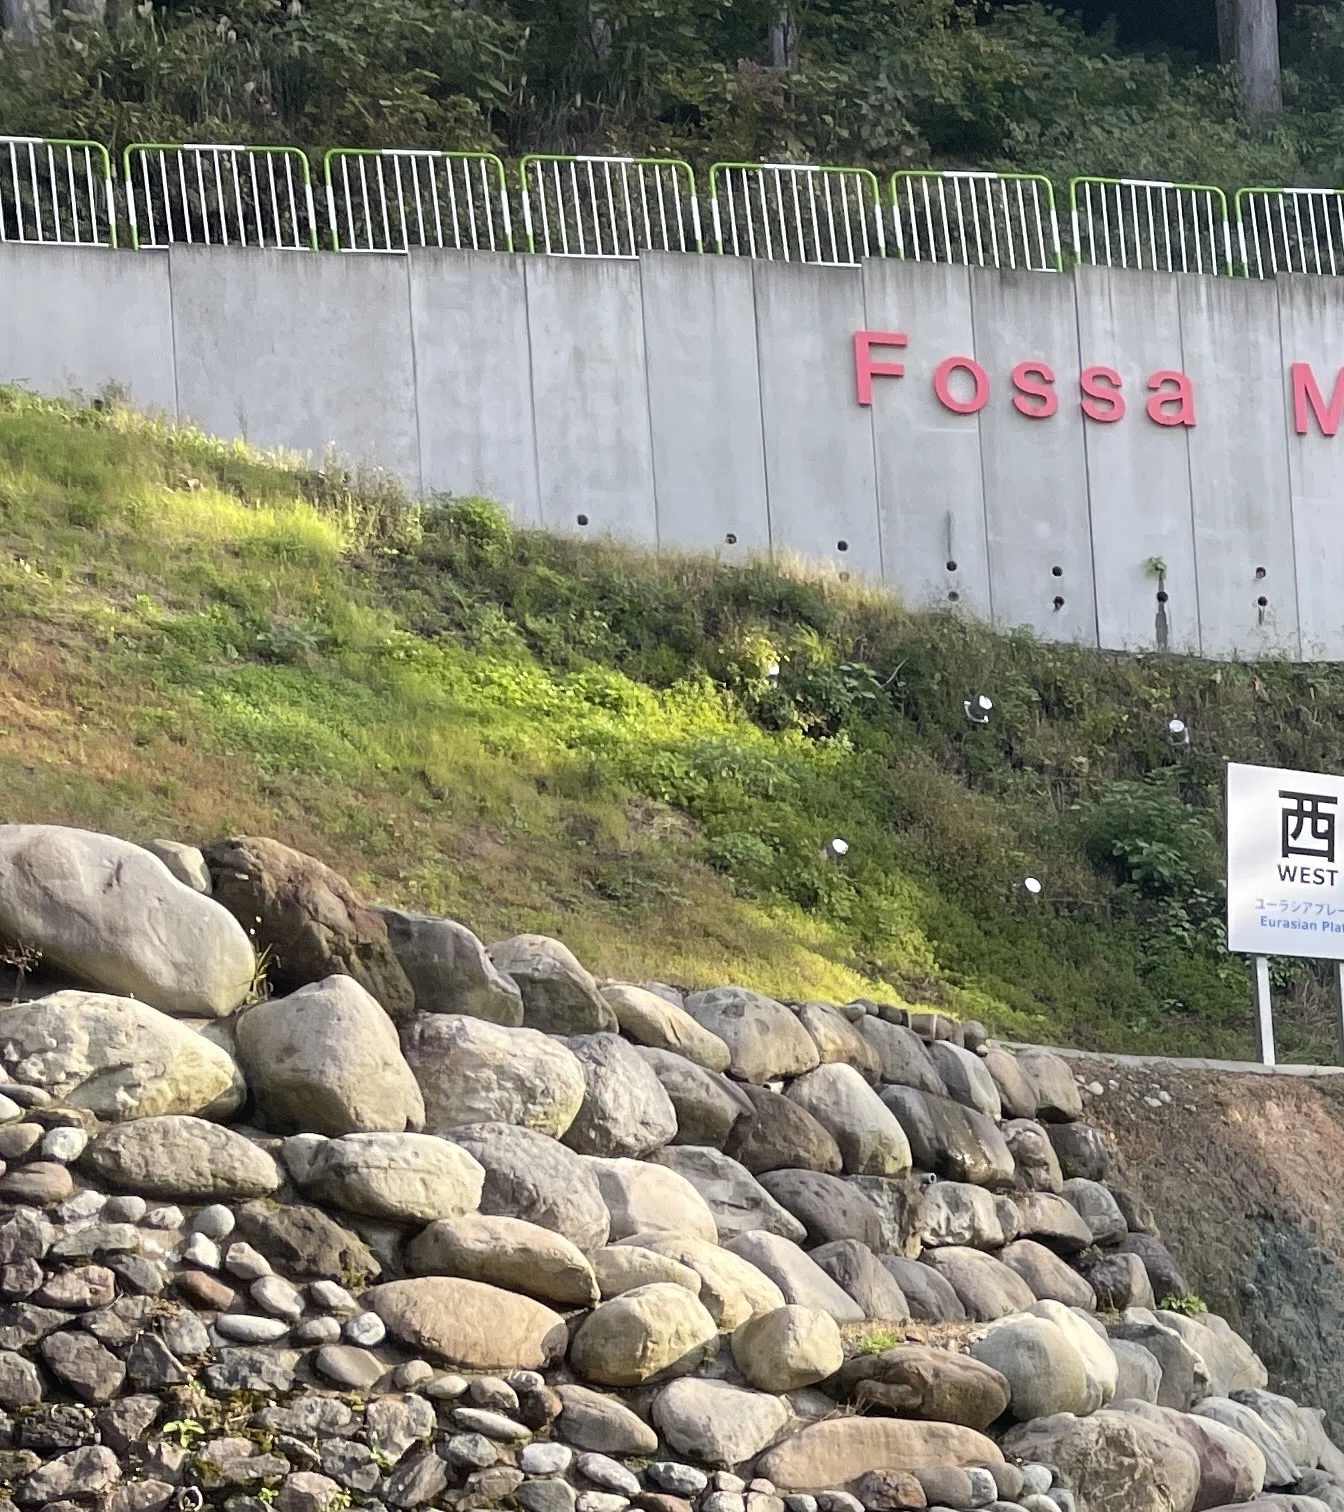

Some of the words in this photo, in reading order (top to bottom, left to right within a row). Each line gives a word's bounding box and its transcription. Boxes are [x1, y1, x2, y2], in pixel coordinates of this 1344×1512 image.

[853, 330, 1197, 427] Fossa
[1278, 789, 1338, 863] 西
[1277, 864, 1339, 887] WEST
[1260, 915, 1317, 931] Eurasian
